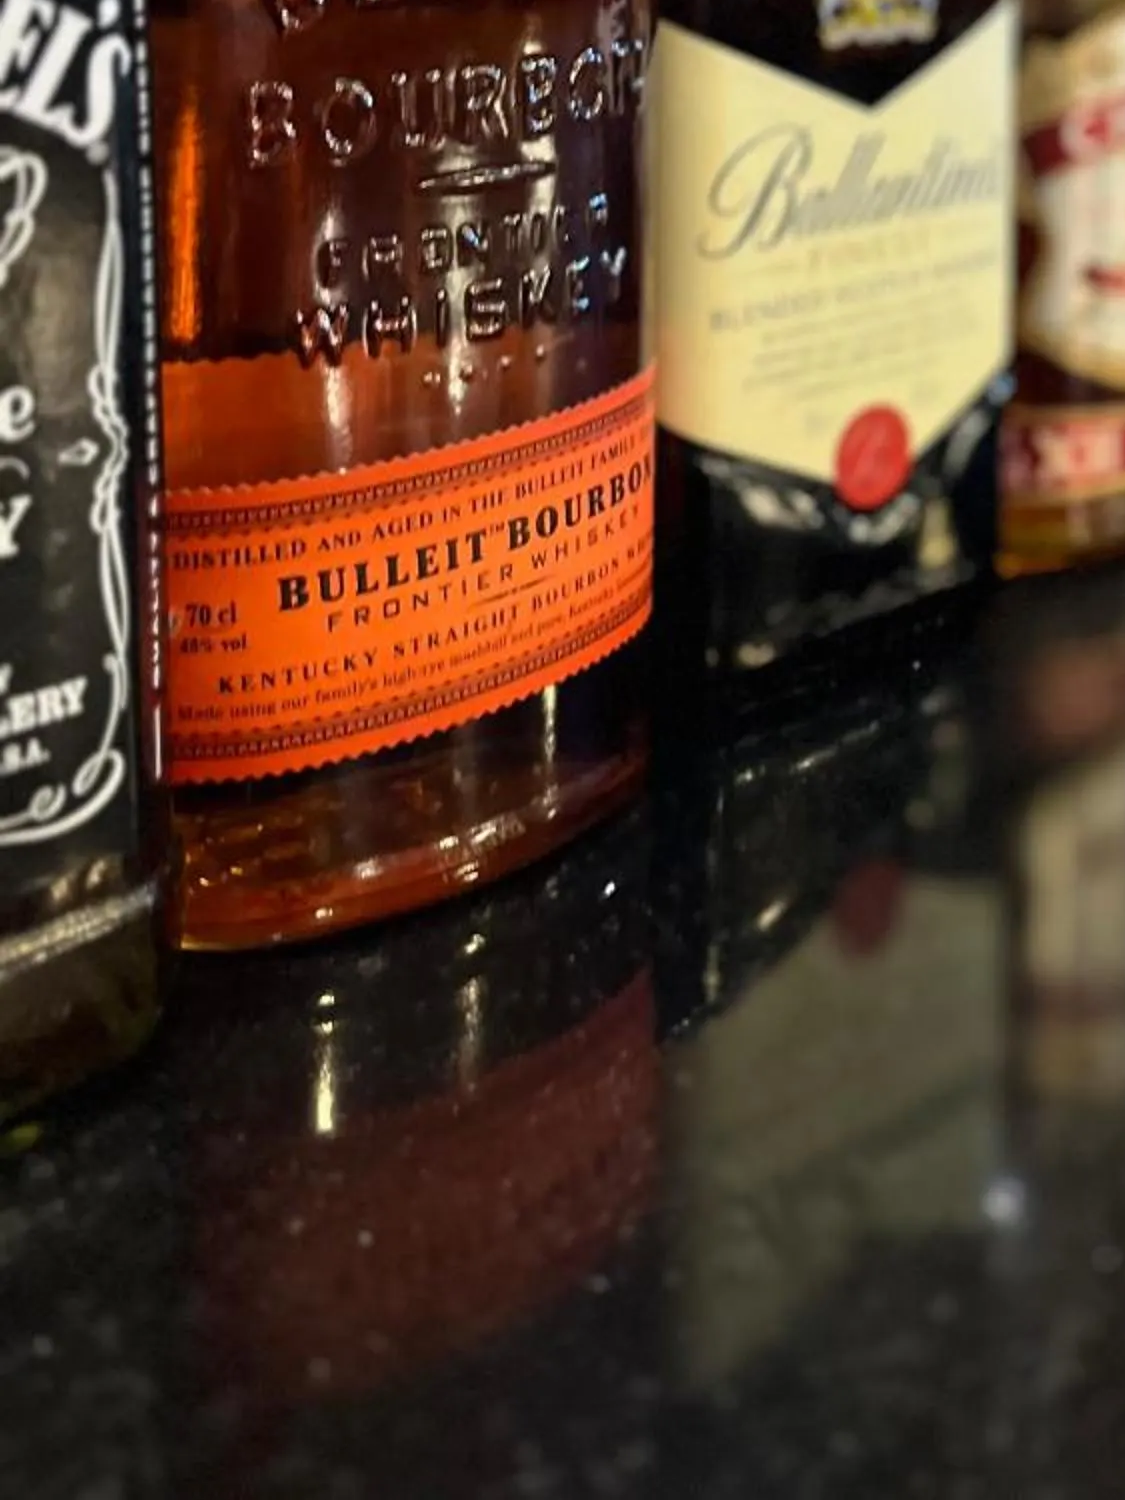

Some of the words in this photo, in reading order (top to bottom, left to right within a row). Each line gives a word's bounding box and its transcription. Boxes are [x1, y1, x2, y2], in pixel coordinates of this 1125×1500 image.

[173, 540, 306, 571] DISTILLED
[318, 531, 361, 552] AND
[373, 511, 433, 541] AGED
[442, 504, 461, 523] IN
[471, 488, 508, 514] THE
[515, 459, 583, 500] BULLEIT
[185, 602, 212, 628] 70
[218, 599, 237, 625] cl
[278, 528, 487, 612] BULLEIT
[328, 563, 513, 633] FRONTIER
[531, 503, 640, 570] WHISKEY
[219, 647, 377, 694] KENTUCKY
[393, 603, 520, 660] STRAIGHT
[531, 557, 620, 612] BOURBON
[221, 632, 247, 653] vol
